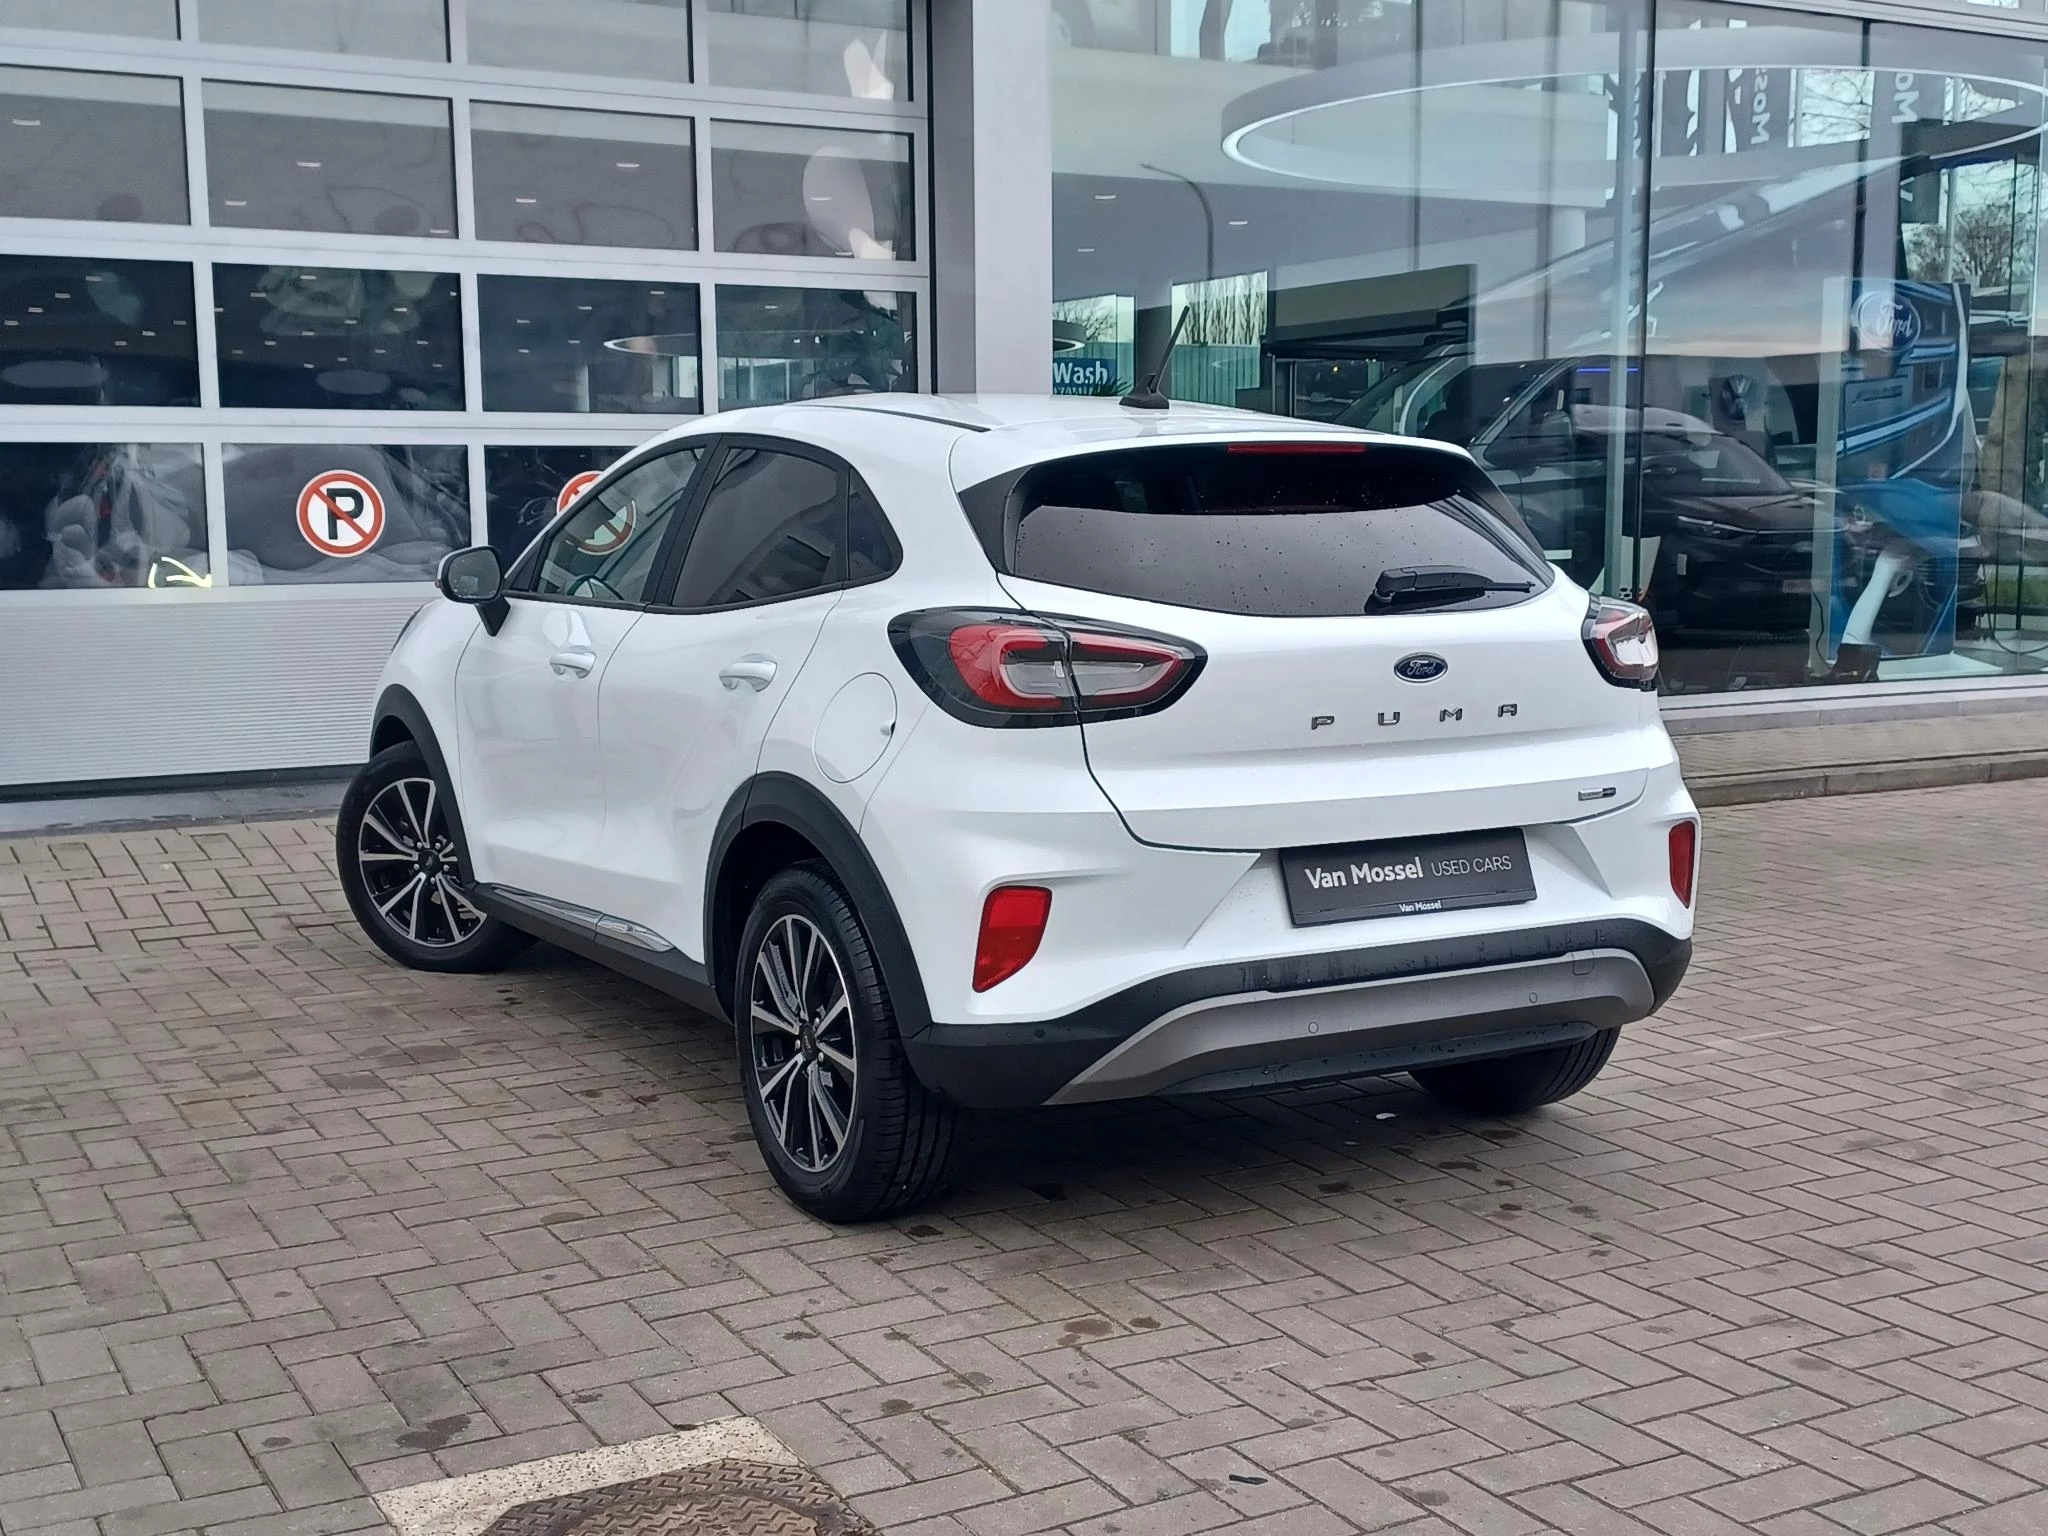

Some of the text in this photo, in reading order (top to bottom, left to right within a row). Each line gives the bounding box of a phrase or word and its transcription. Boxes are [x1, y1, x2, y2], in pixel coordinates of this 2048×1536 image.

[1053, 360, 1108, 384] Wash
[326, 488, 364, 540] P
[1311, 703, 1518, 730] PUMA
[1304, 855, 1512, 889] Van Mossel USED CARS
[1399, 900, 1442, 912] Van Mossel
